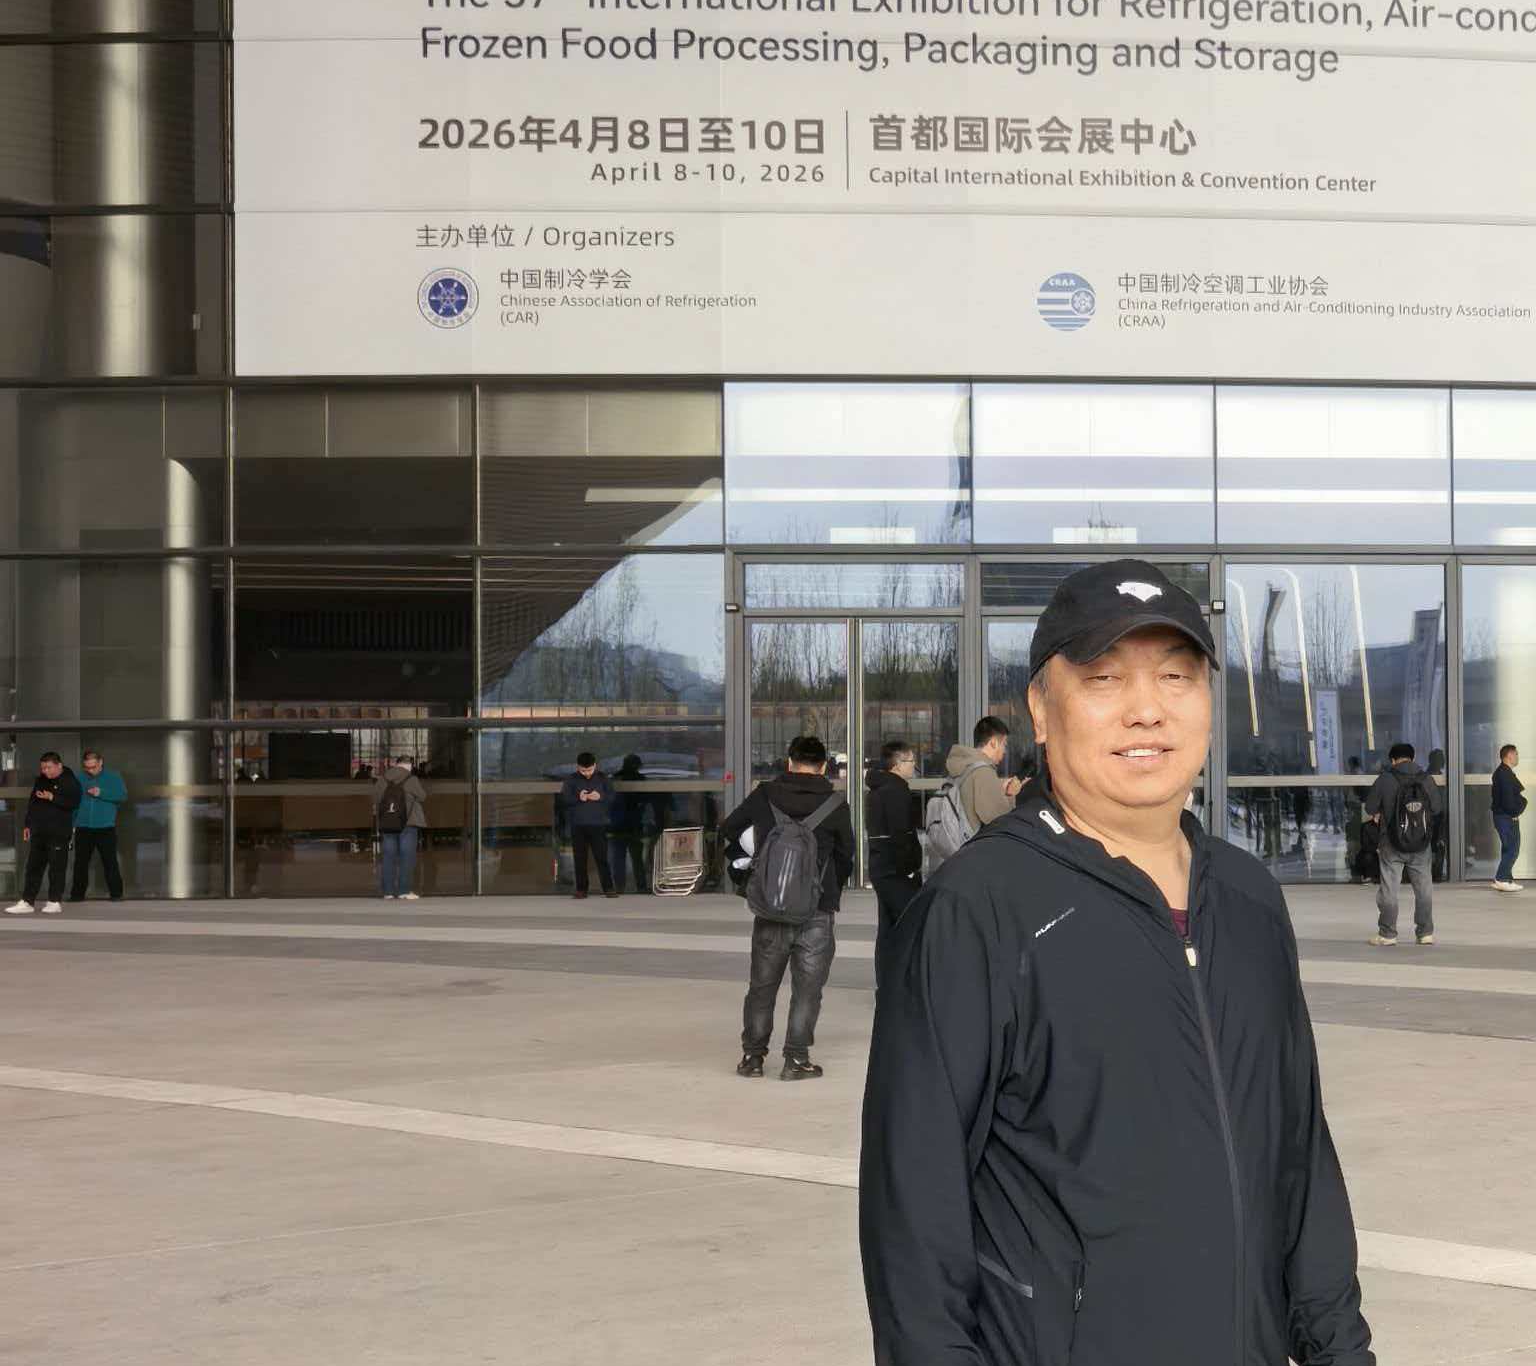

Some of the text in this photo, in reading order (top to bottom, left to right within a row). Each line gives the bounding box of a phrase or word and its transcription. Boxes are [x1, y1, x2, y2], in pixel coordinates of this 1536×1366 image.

[420, 27, 1339, 80] Frozen Food Processing, Packaging and Storage
[417, 115, 825, 155] 2026年4月8日至10日
[869, 115, 1197, 157] 首都国际会展中心
[591, 161, 825, 186] April 8-10, 2026
[869, 166, 1376, 193] Capital International Exhibition & Convention Center
[416, 225, 515, 249] 主办单位
[543, 226, 675, 252] Organizers
[500, 268, 631, 291] 中国制冷学会
[1117, 273, 1329, 297] 中国制冷空调工业协会
[500, 294, 757, 311] Chinese Association of Refrigeration
[1118, 298, 1157, 311] China
[1161, 299, 1249, 314] Refrigeration
[1254, 300, 1280, 313] and
[1399, 303, 1451, 320] Industry
[1456, 304, 1531, 318] Association
[500, 311, 539, 326] (CAR)
[1117, 313, 1166, 329] (CRAA)
